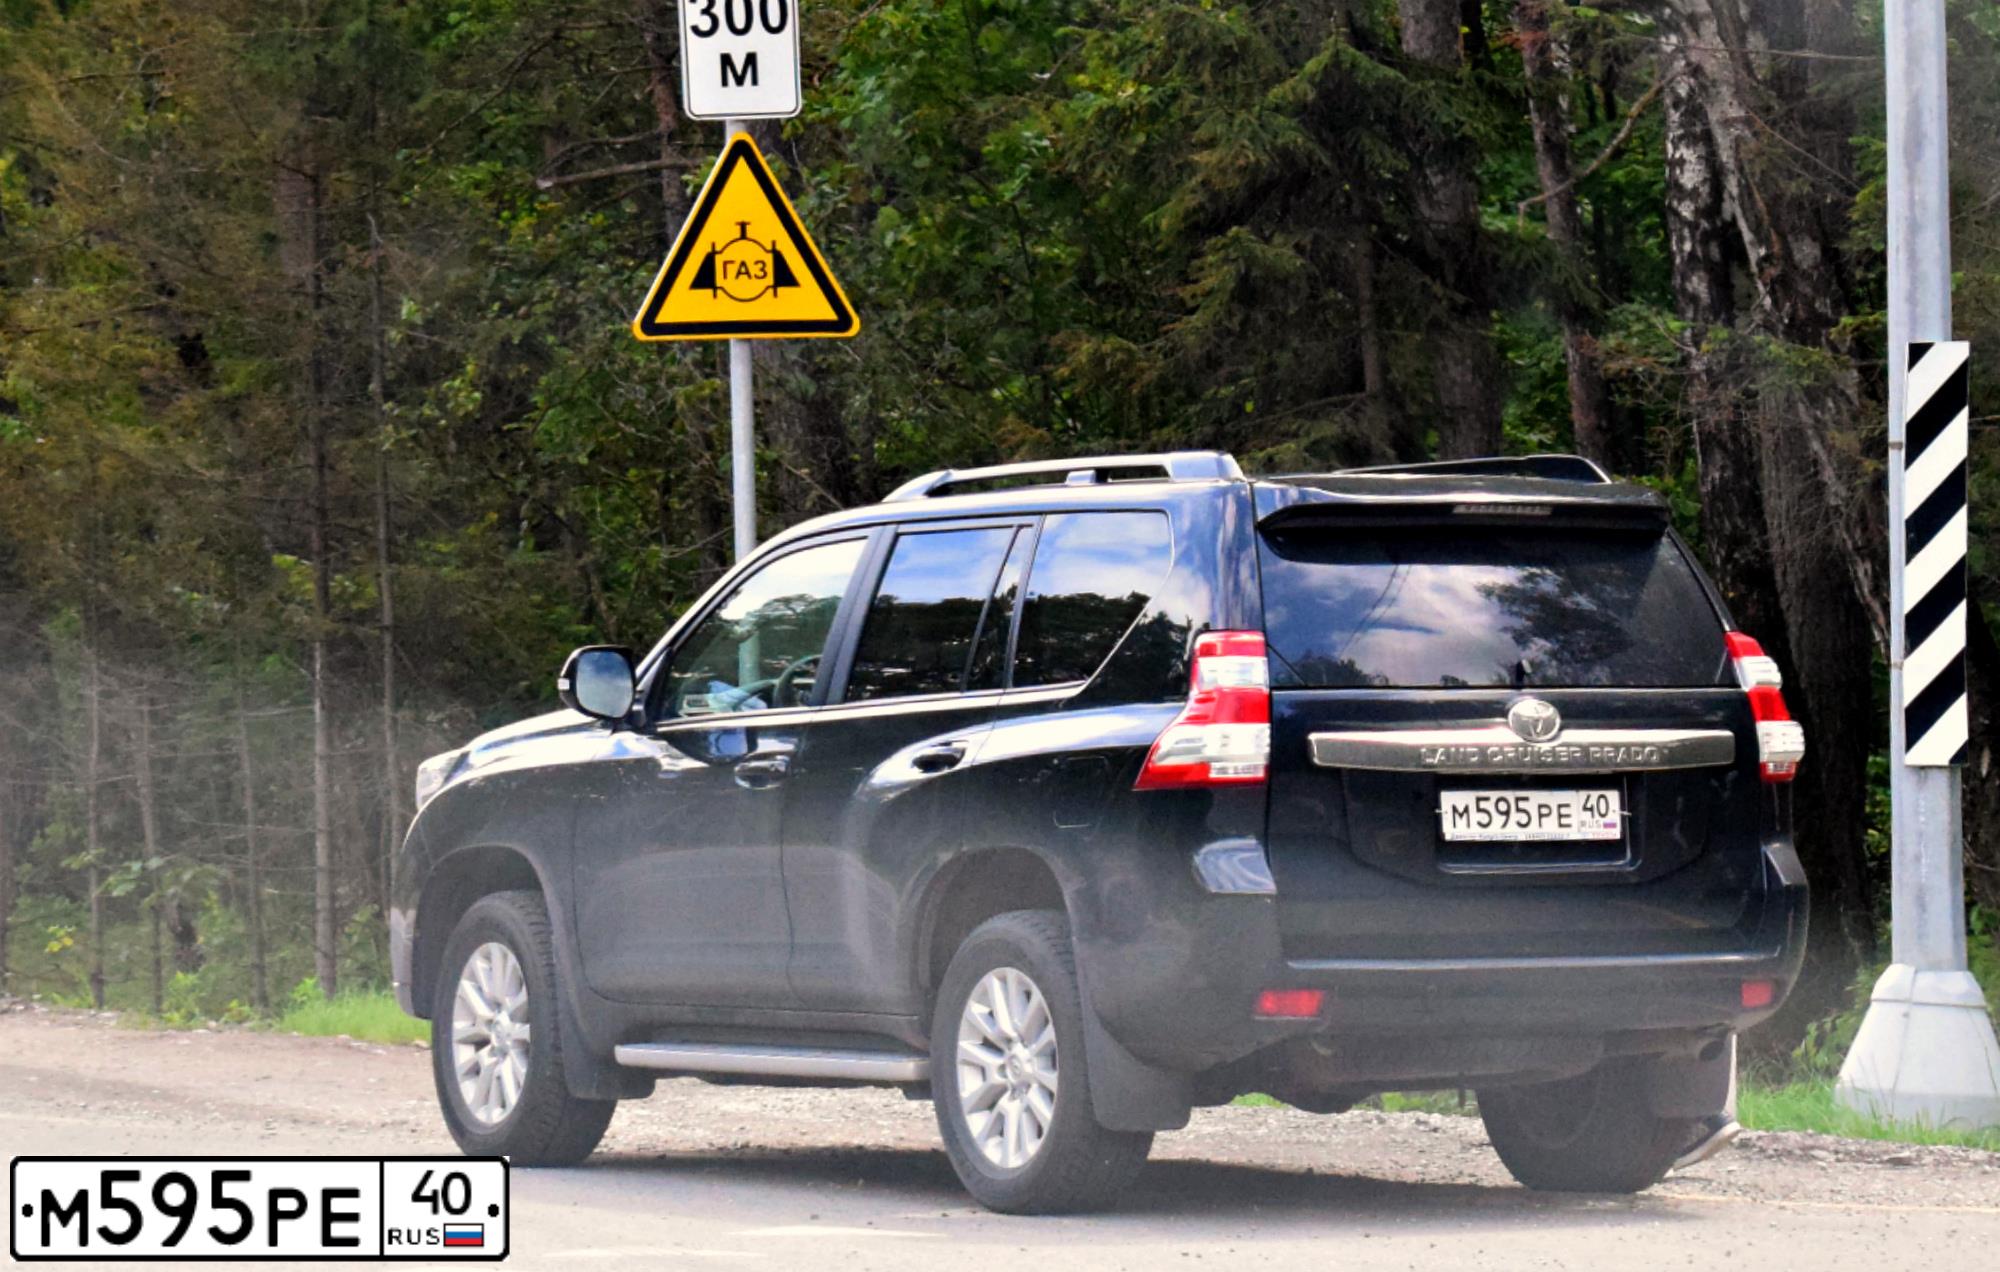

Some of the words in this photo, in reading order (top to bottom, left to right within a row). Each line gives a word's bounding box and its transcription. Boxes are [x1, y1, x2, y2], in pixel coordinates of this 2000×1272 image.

[689, 0, 789, 38] 300
[722, 259, 769, 281] ГАЗ
[1420, 747, 1480, 764] LAND
[1487, 747, 1584, 764] CRUISER
[1589, 747, 1660, 764] PRADO
[1582, 793, 1610, 819] 40
